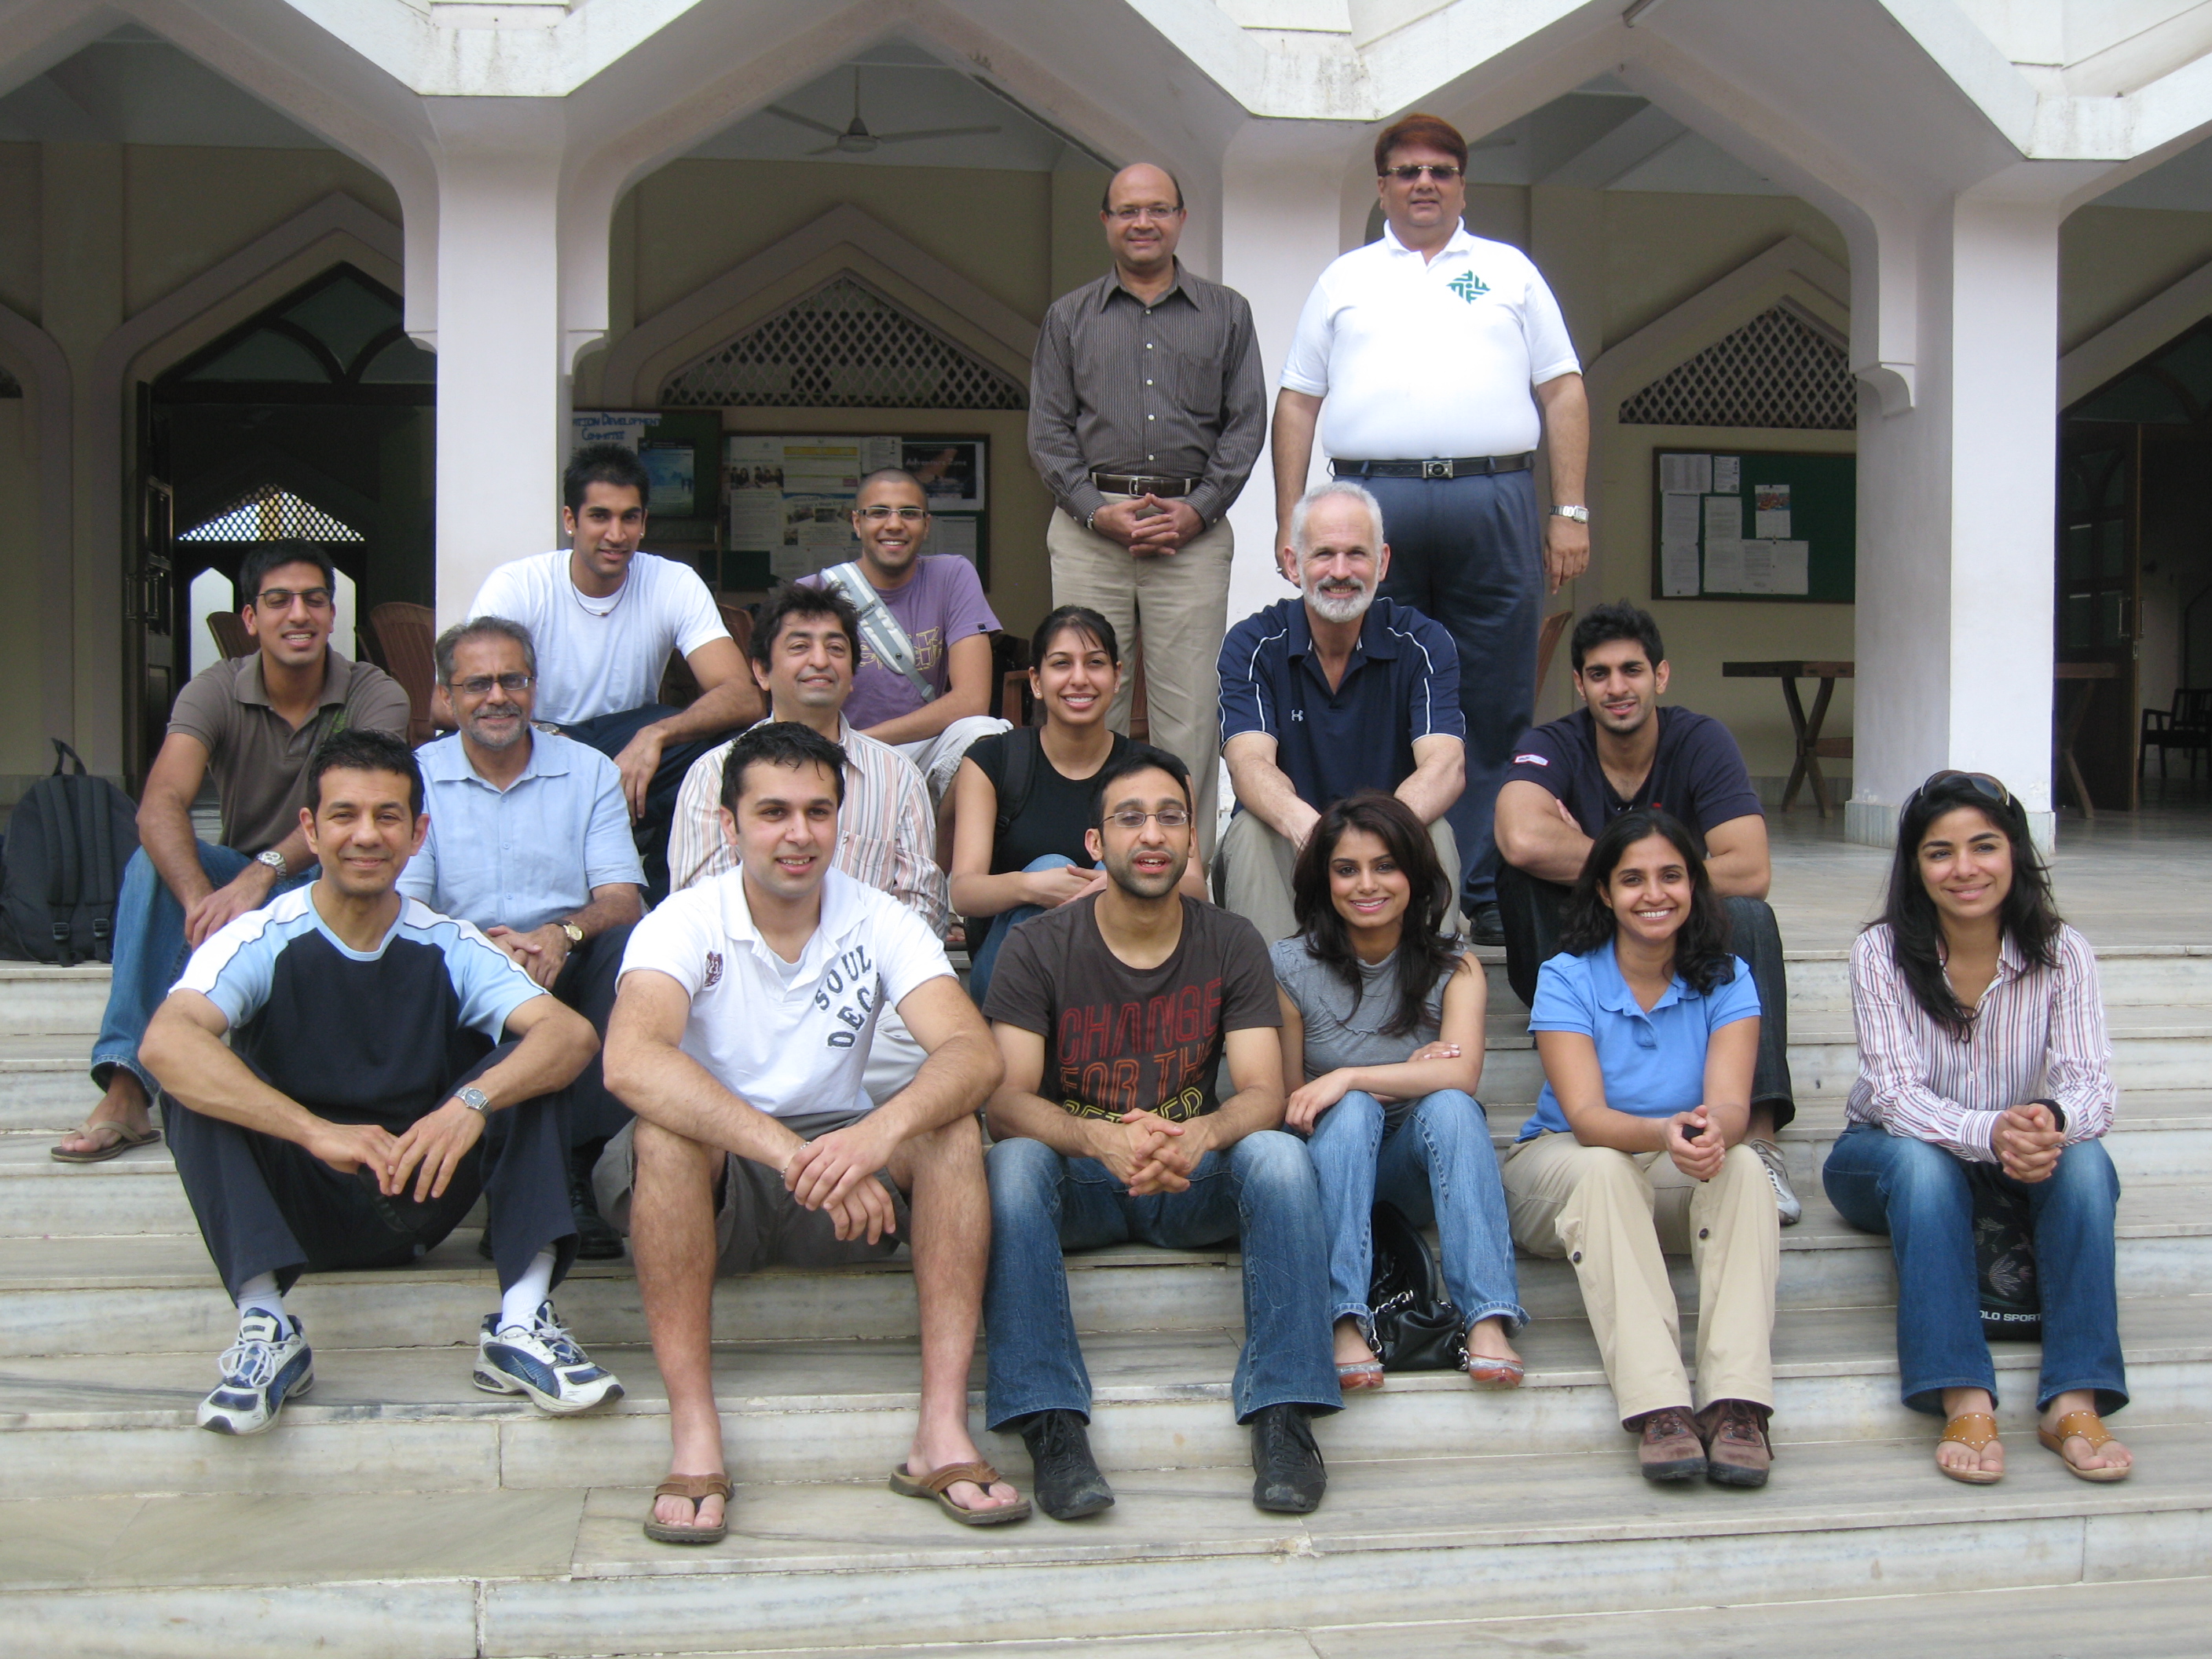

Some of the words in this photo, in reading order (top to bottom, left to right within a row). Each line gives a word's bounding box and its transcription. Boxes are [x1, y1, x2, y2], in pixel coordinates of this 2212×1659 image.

[815, 945, 872, 1011] SOUL
[1057, 978, 1222, 1066] CHANGE
[1060, 1059, 1140, 1112] FOR
